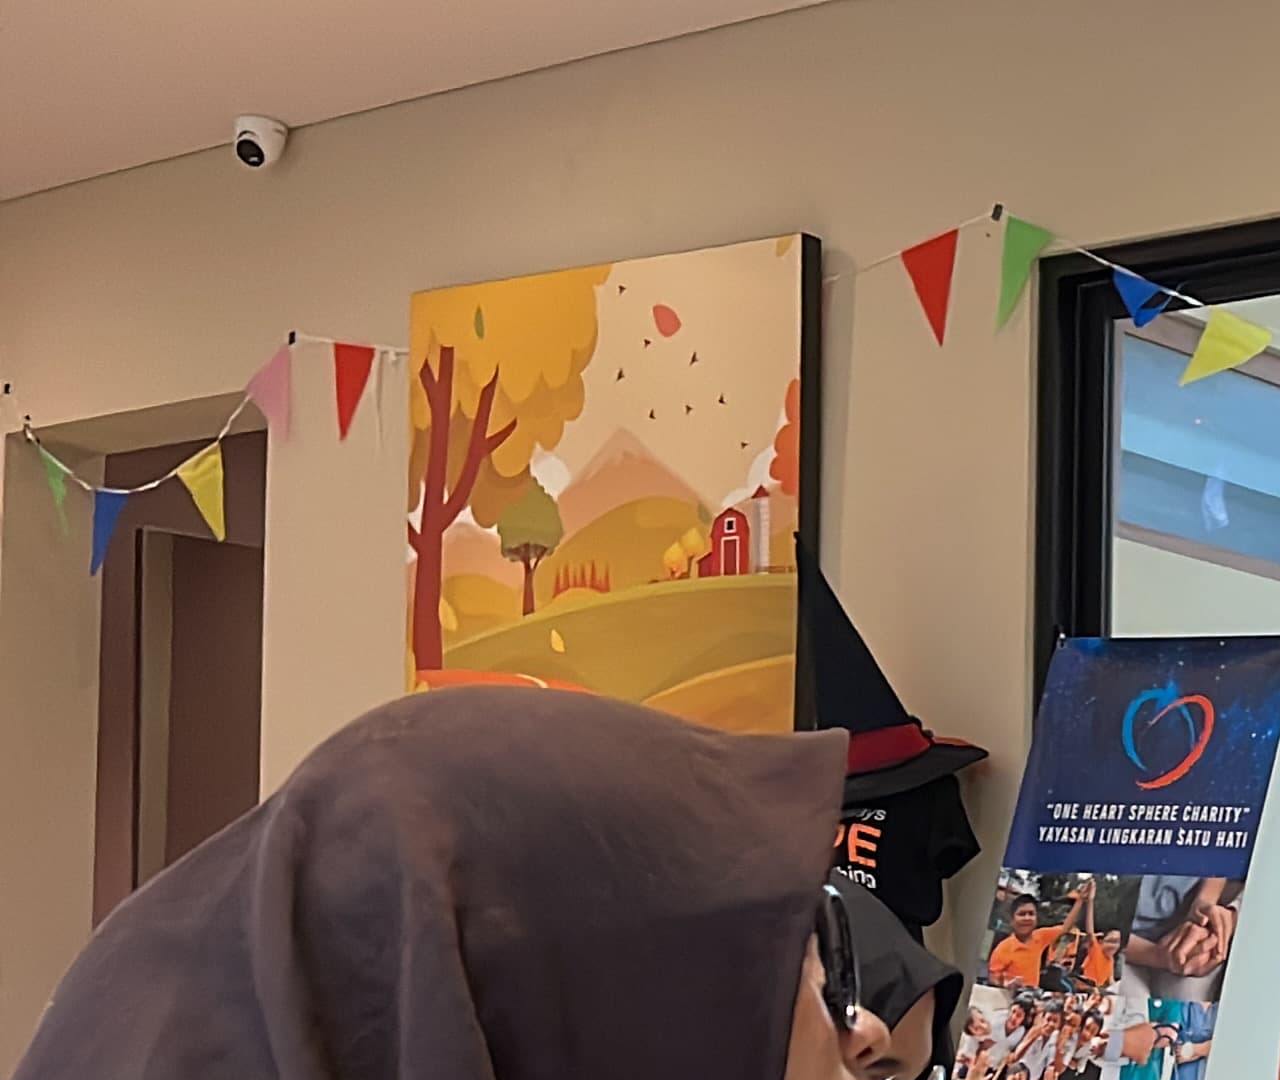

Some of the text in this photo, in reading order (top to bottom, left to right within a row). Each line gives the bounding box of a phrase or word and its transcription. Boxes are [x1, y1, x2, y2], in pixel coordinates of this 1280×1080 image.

[1082, 804, 1126, 821] HEART
[1128, 805, 1179, 822] SPHERE
[1038, 826, 1248, 848] YAYASAN LINGKARAN SATU HATI
